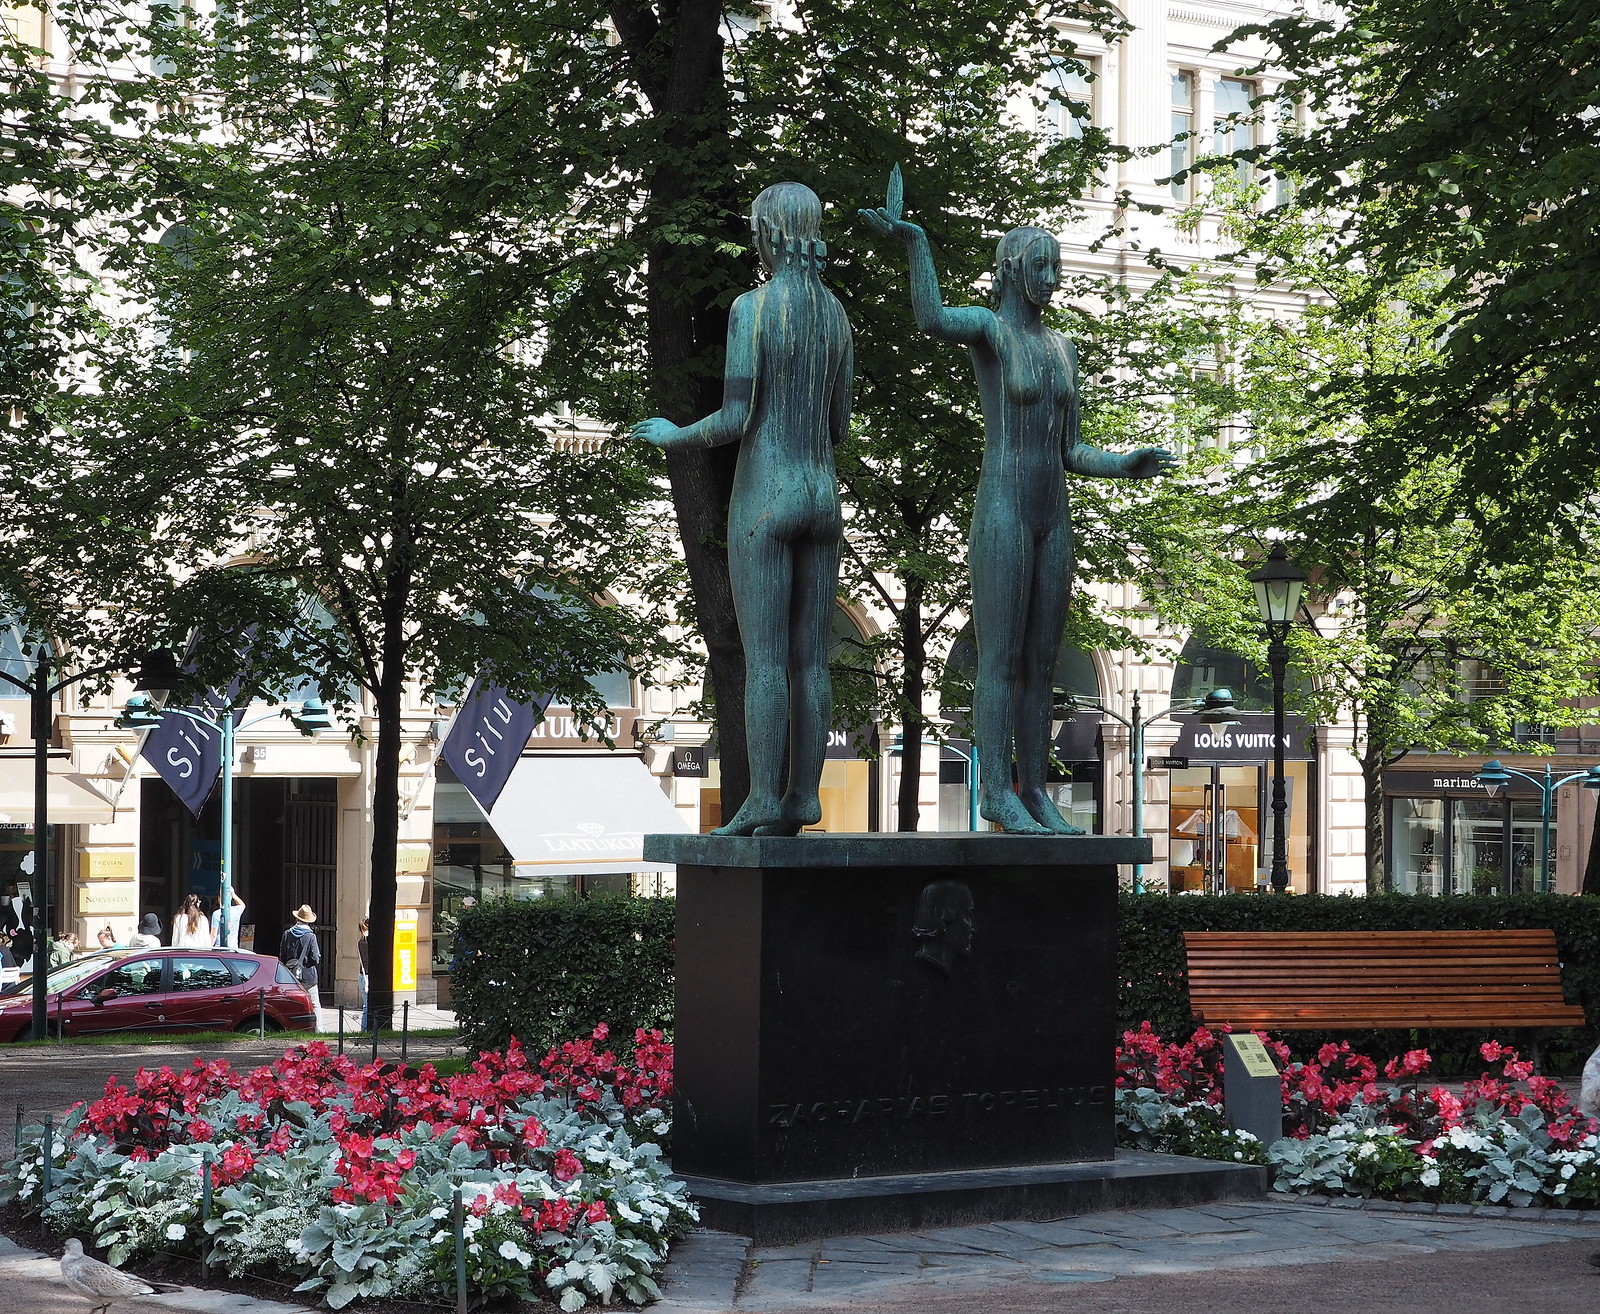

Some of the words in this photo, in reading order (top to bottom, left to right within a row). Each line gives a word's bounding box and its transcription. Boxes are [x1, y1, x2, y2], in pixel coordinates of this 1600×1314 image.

[1194, 733, 1232, 749] LOUIS
[254, 748, 266, 759] 35
[677, 762, 701, 771] OMEGA
